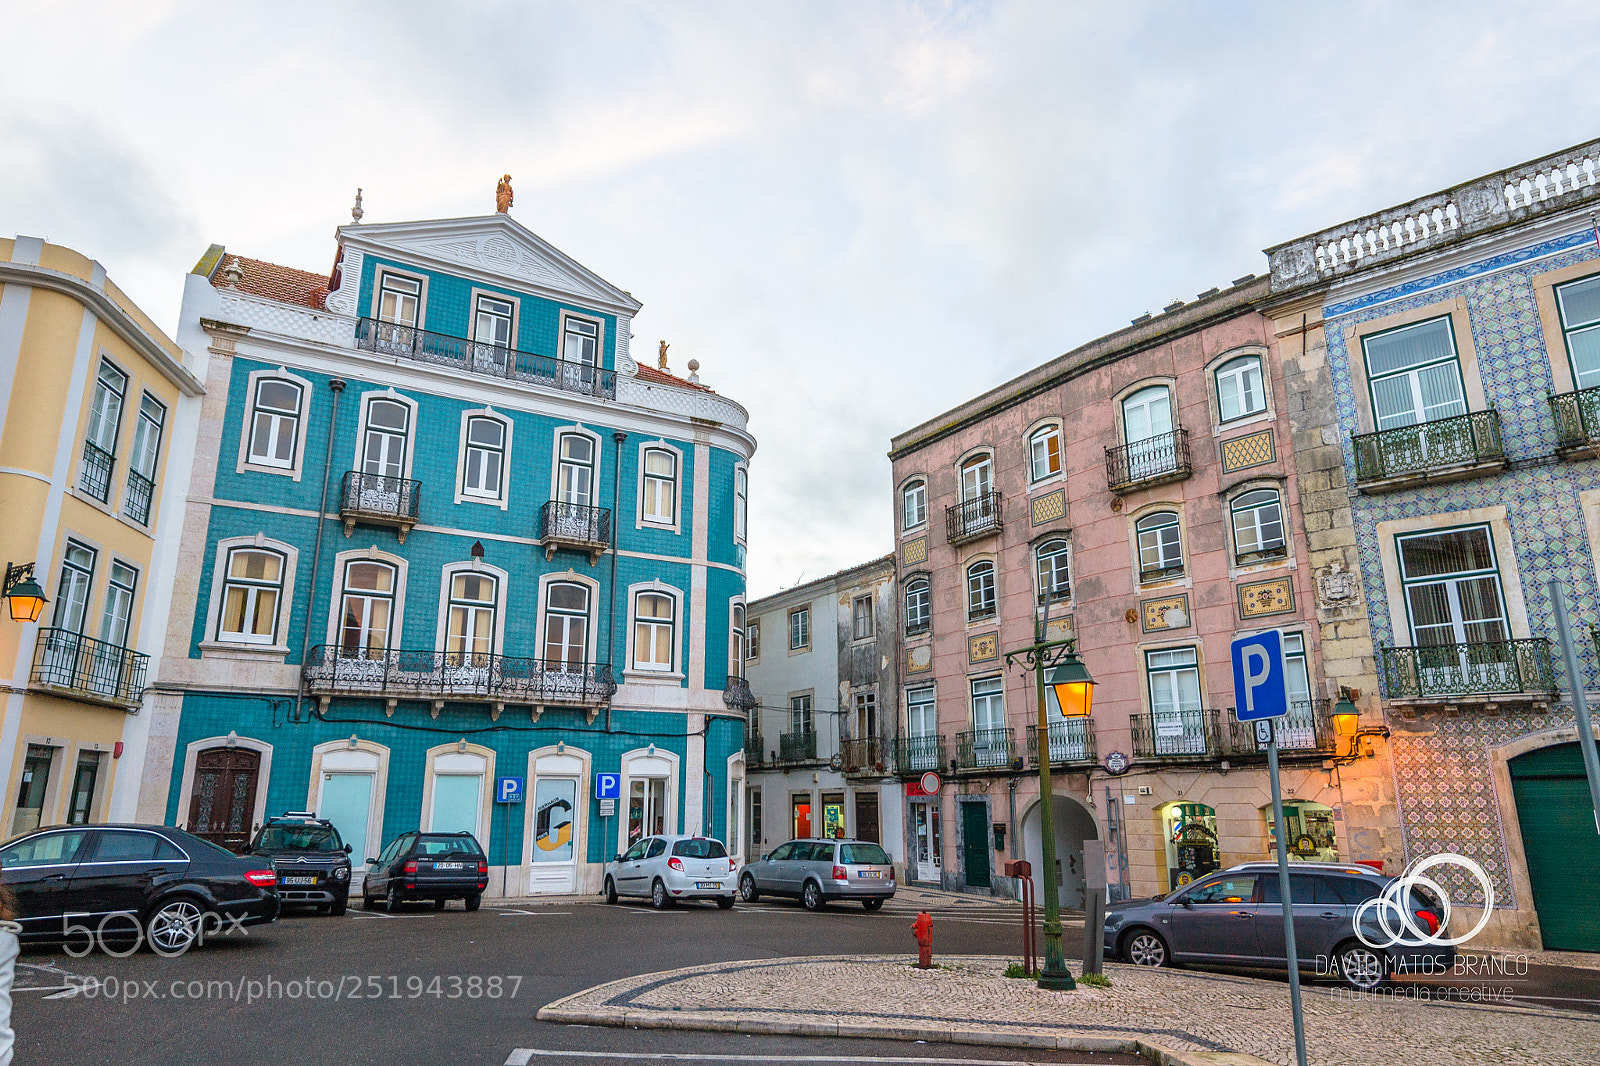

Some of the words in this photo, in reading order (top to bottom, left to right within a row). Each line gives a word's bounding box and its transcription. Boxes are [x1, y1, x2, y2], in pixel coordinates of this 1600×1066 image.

[1241, 643, 1271, 712] P
[502, 779, 518, 800] P
[601, 775, 616, 797] P
